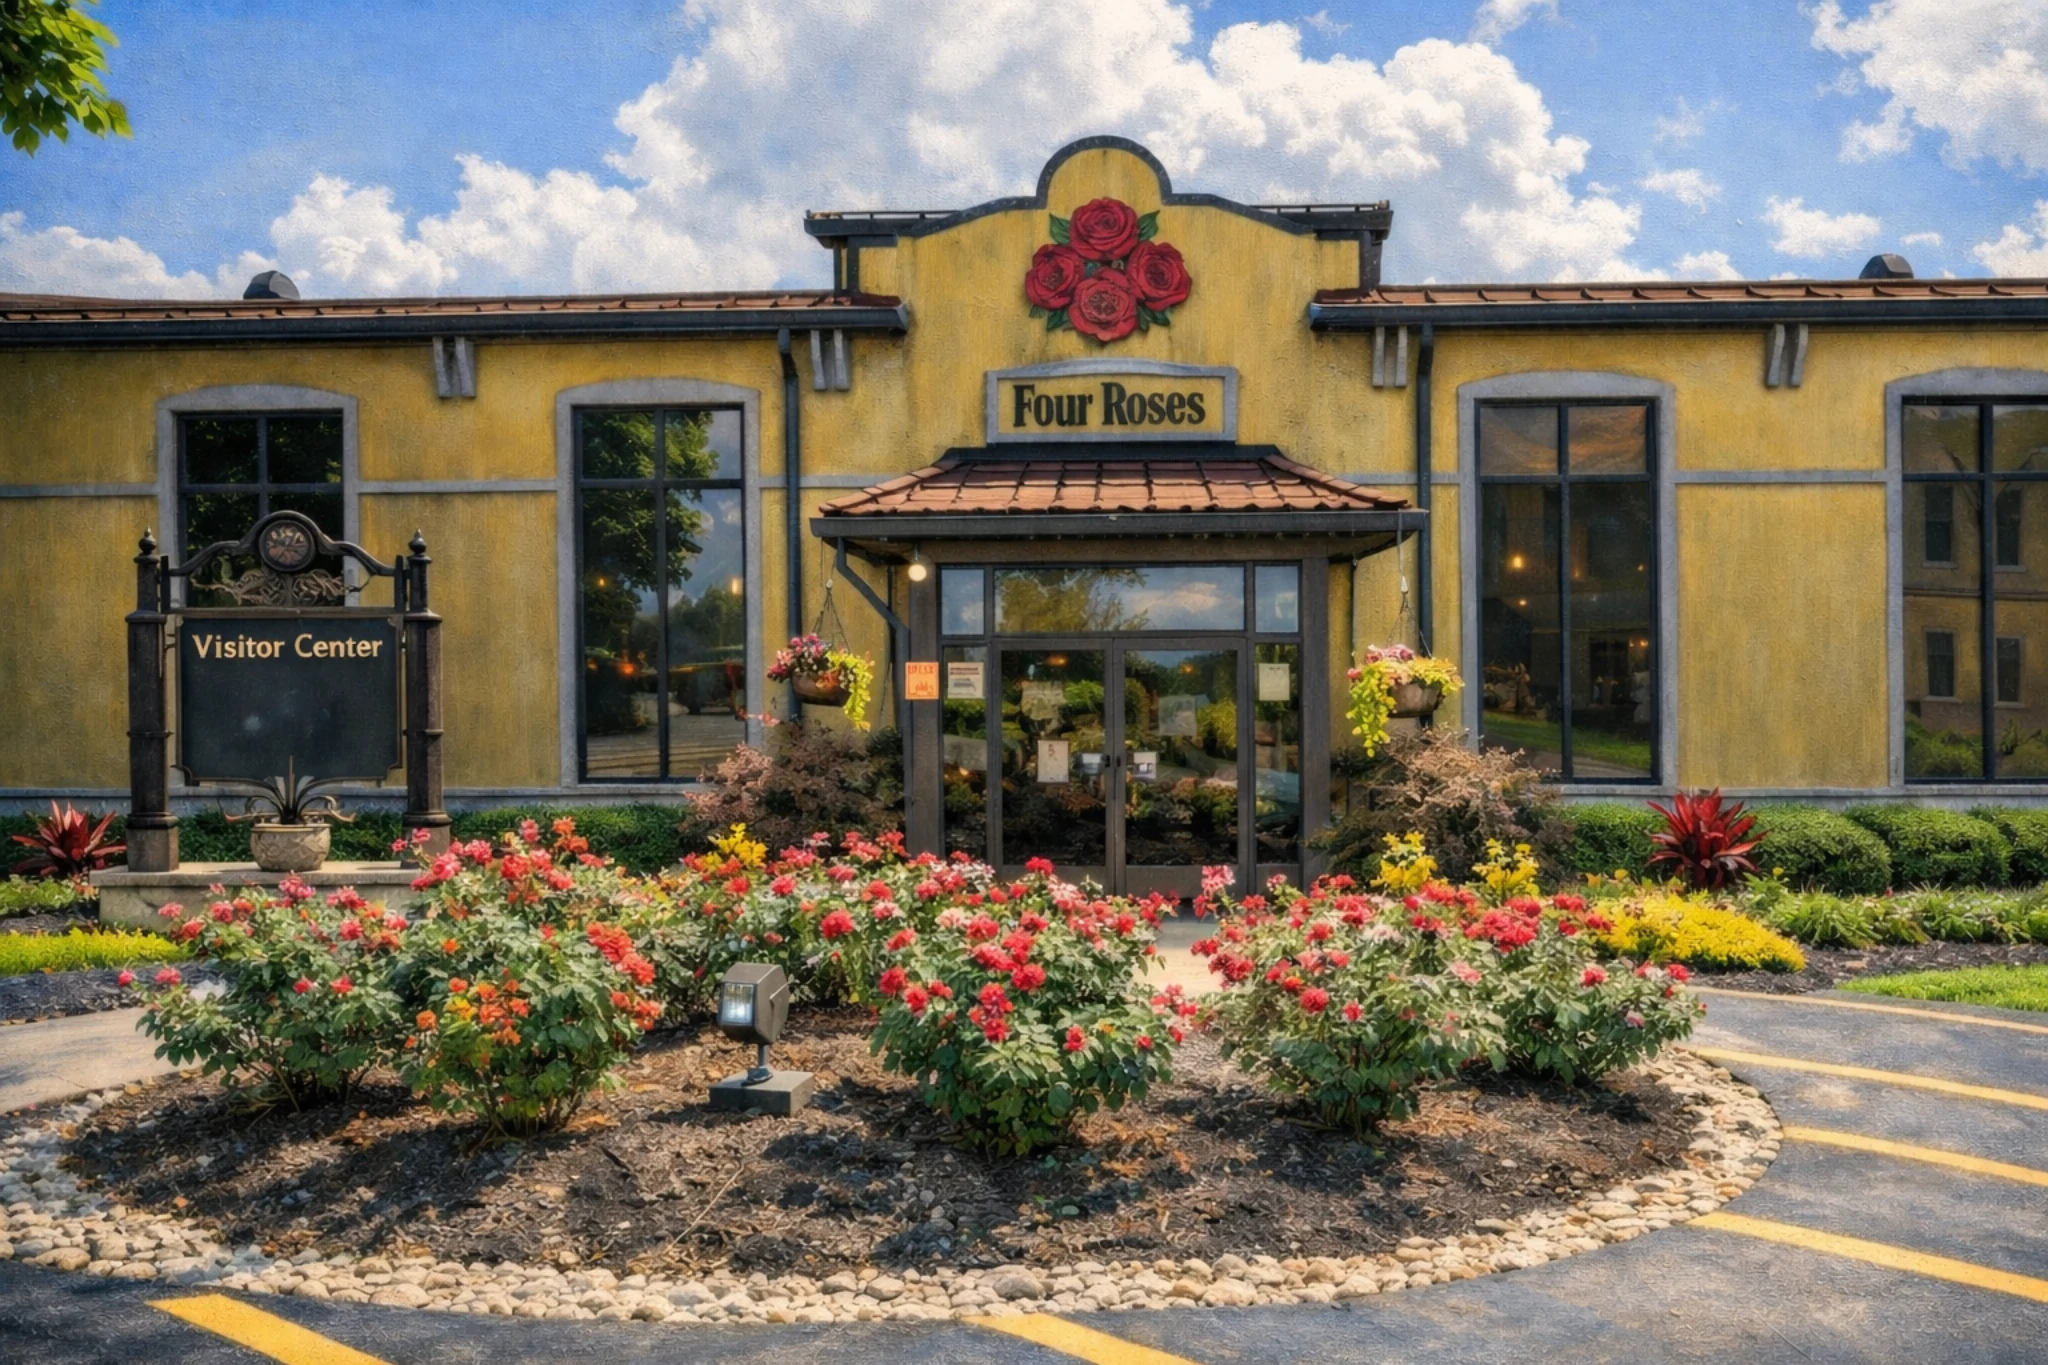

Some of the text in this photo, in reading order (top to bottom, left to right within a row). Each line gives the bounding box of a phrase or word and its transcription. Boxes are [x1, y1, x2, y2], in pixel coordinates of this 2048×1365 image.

[1013, 382, 1206, 427] Four Roses
[191, 633, 383, 659] Visitor Center
